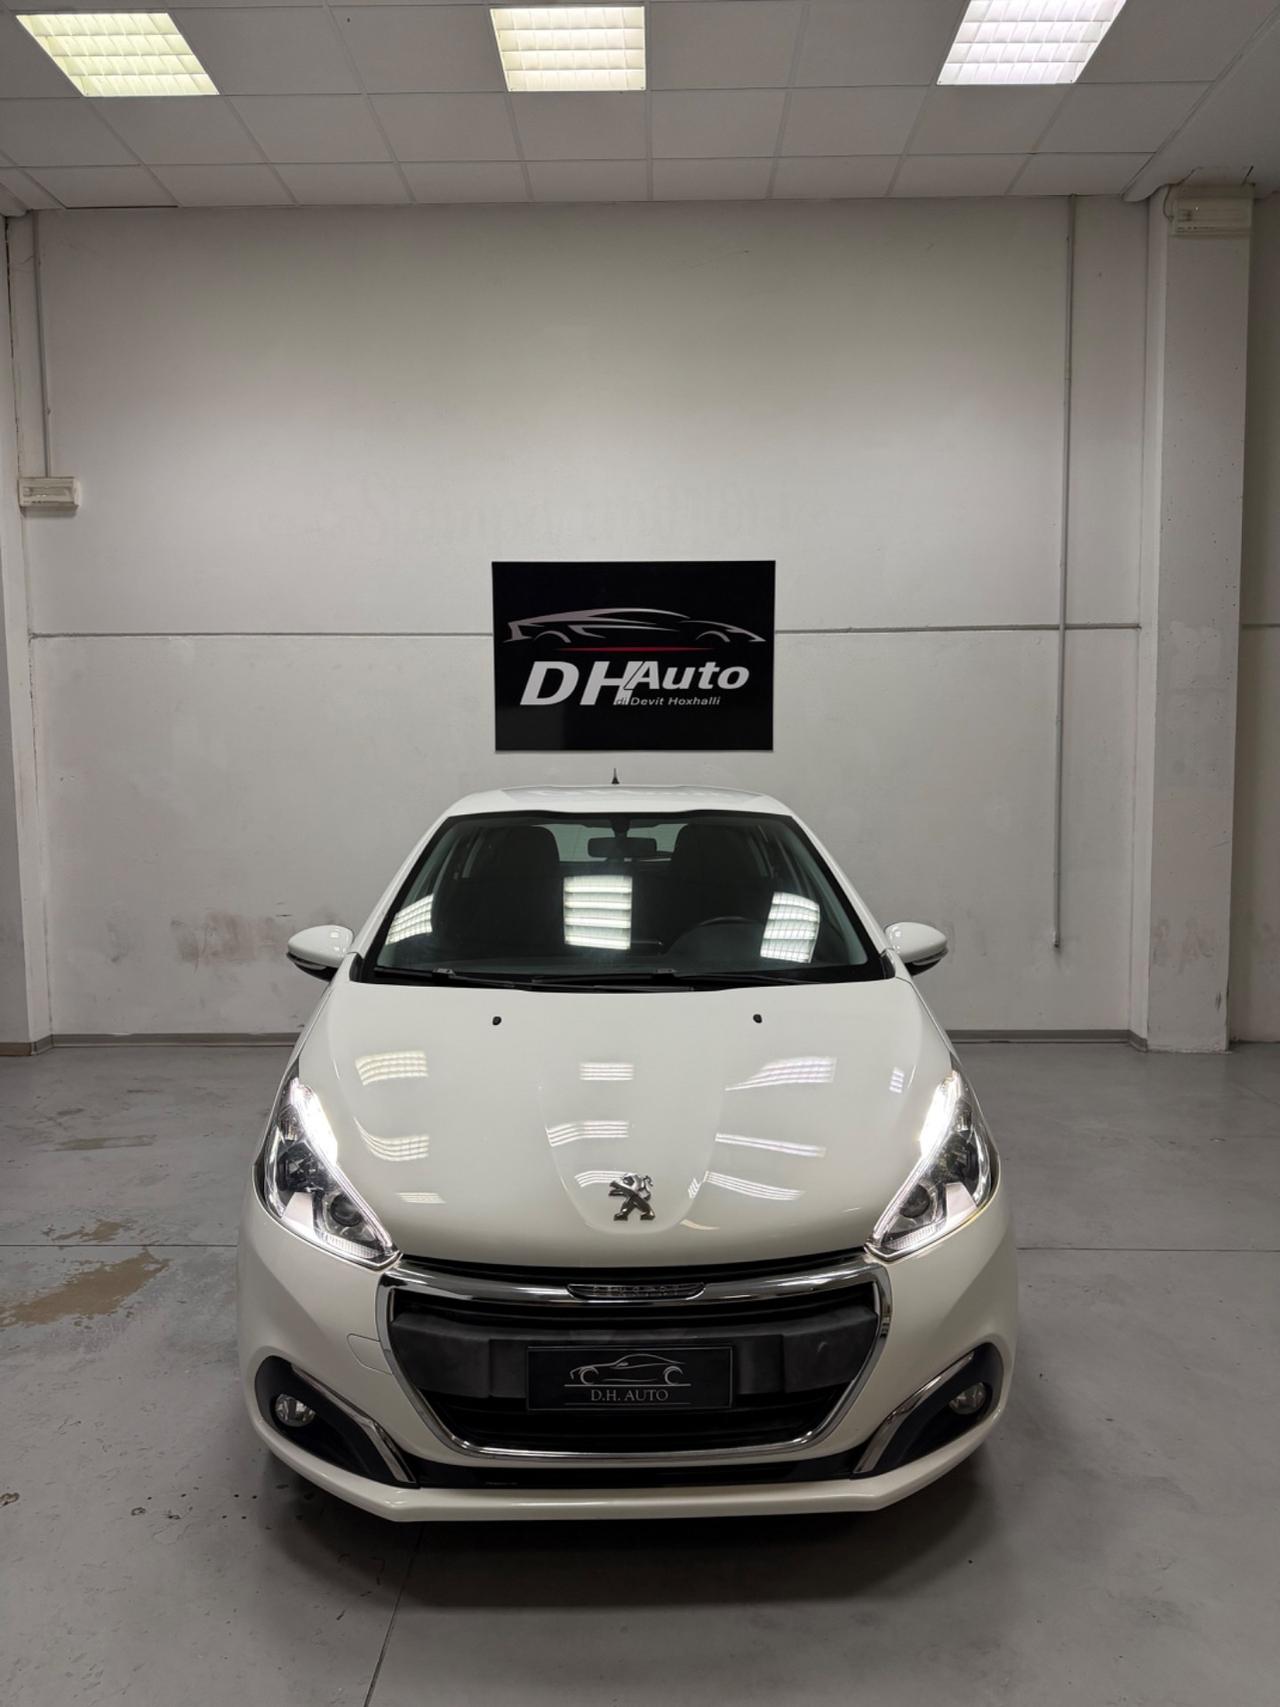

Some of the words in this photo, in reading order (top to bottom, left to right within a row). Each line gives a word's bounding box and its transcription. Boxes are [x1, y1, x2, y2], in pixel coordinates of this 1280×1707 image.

[630, 696, 665, 706] Devit
[667, 696, 721, 706] Hoxhalli
[590, 1389, 621, 1402] D.H.
[624, 1389, 669, 1402] AUTO
